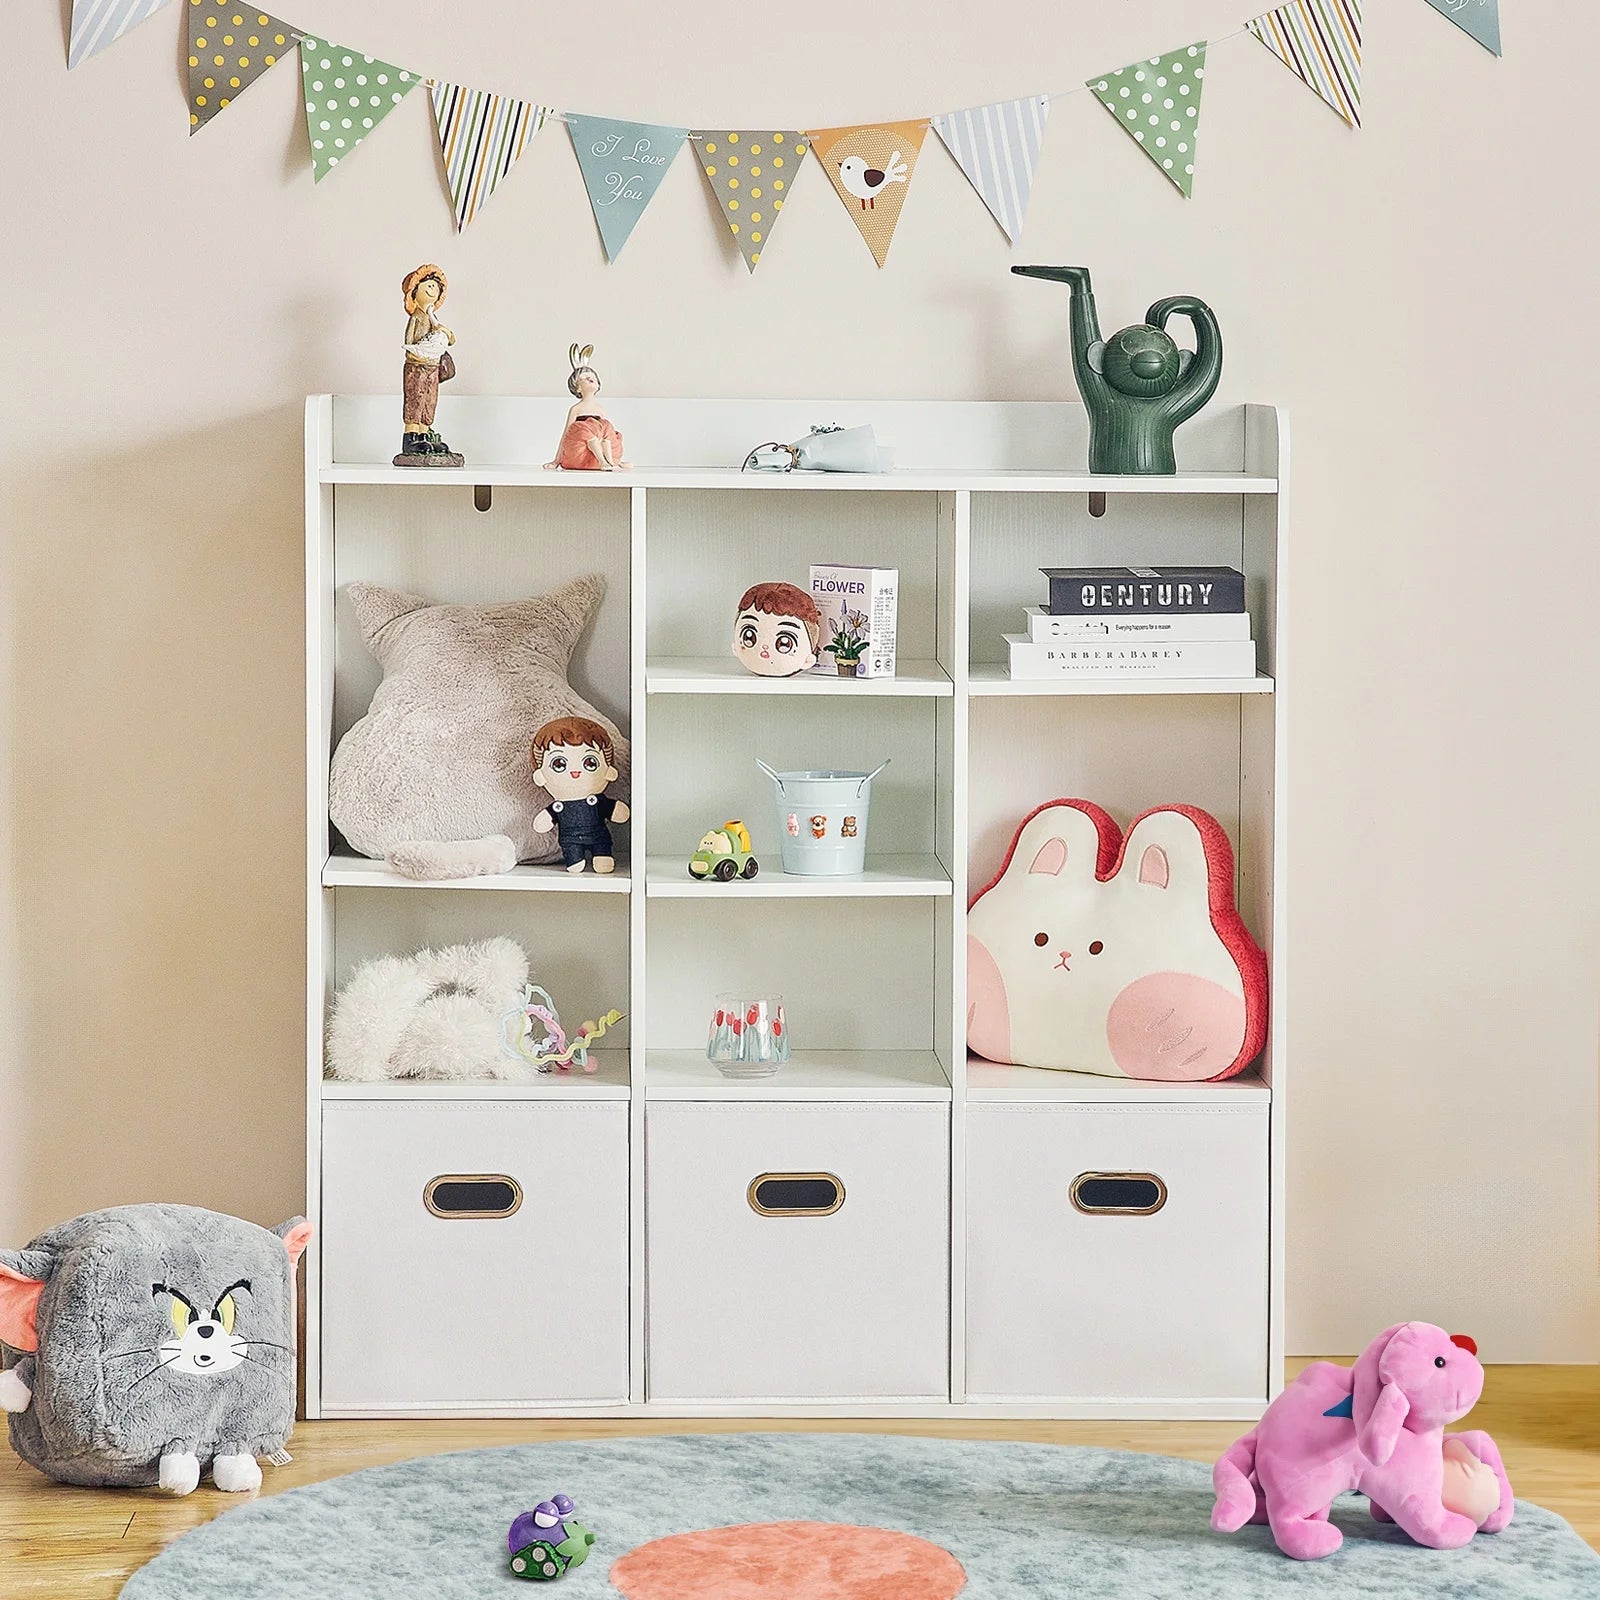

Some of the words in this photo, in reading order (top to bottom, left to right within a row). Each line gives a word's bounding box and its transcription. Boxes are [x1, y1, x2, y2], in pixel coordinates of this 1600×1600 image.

[591, 134, 624, 157] I
[622, 138, 666, 166] Love
[596, 171, 644, 206] You
[812, 579, 865, 594] FLOWER
